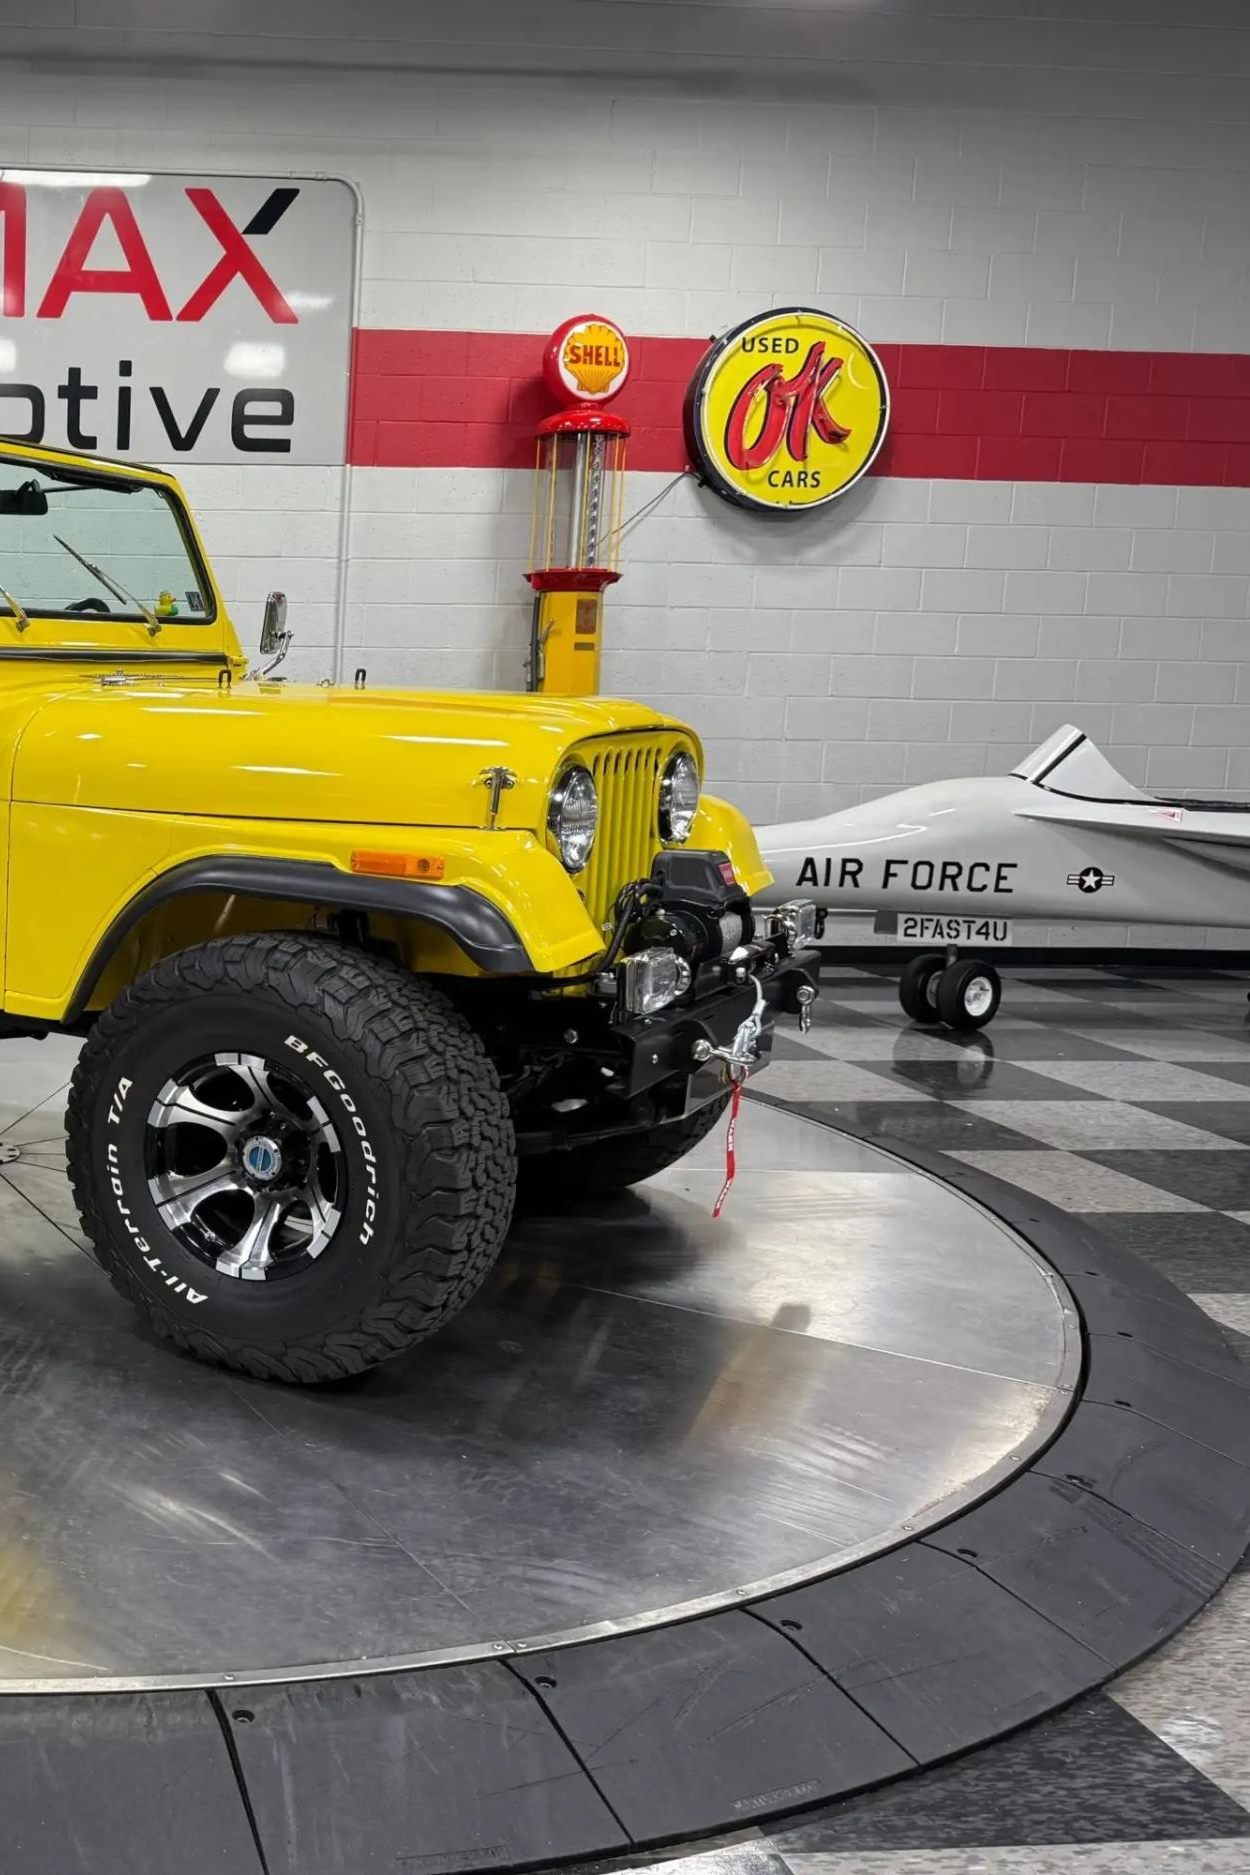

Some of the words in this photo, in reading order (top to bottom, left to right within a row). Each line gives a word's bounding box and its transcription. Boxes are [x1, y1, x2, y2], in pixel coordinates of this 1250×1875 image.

[568, 345, 621, 368] SHELL
[742, 337, 799, 354] USED
[724, 341, 852, 471] OK
[768, 470, 821, 489] CARS
[796, 857, 864, 889] AIR
[881, 859, 1018, 893] FORCE
[903, 917, 1009, 942] 2FAST4U
[107, 1076, 133, 1125] T/A
[284, 1035, 381, 1246] BFGoodrich
[105, 1143, 209, 1304] All-Terrain
